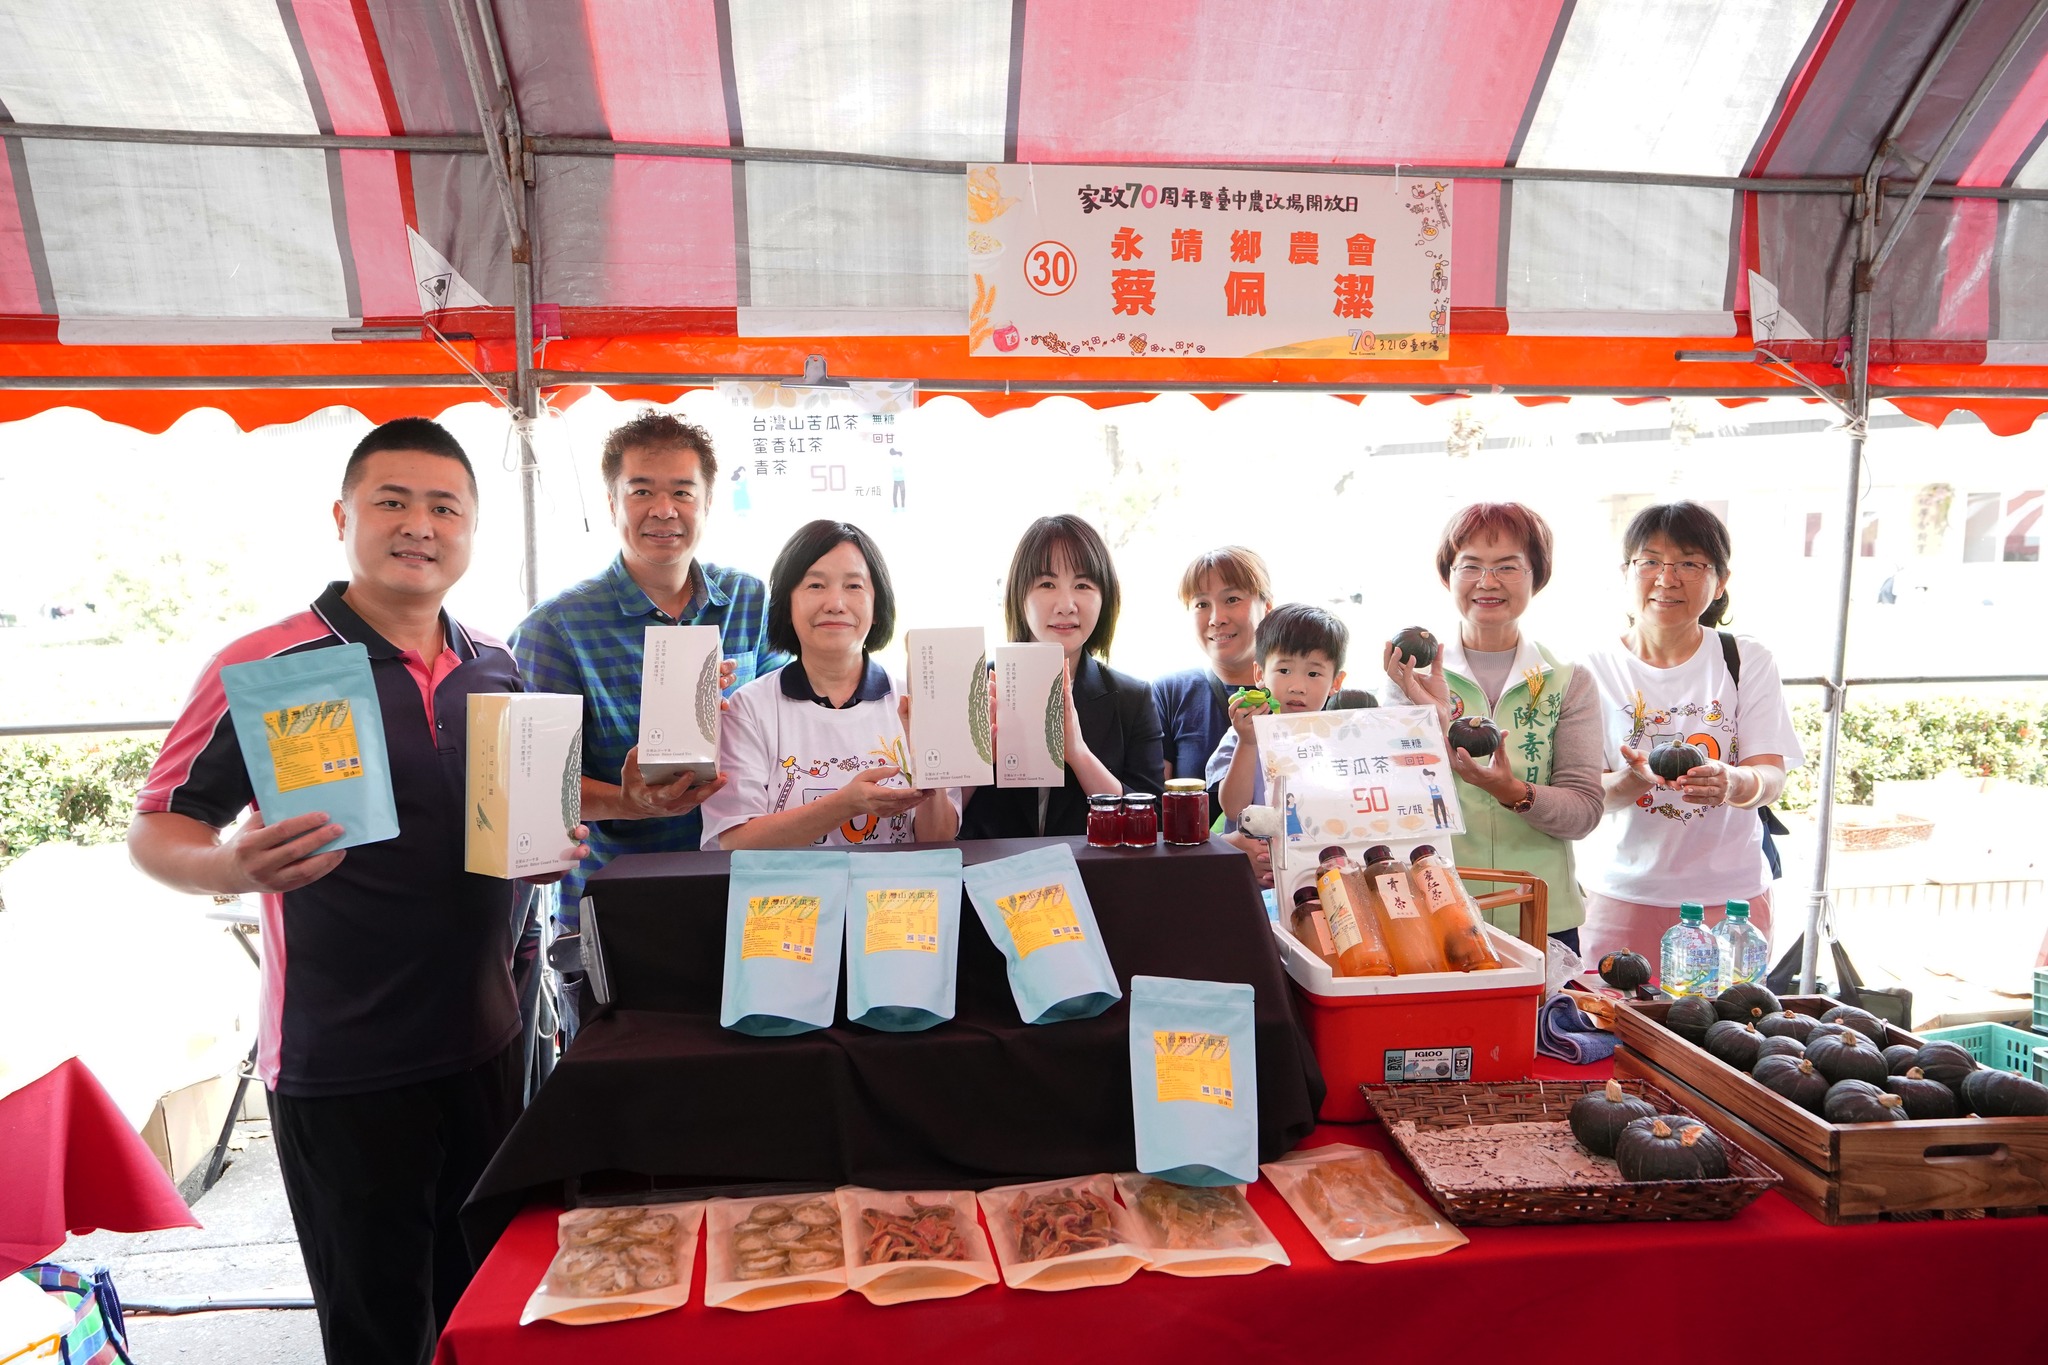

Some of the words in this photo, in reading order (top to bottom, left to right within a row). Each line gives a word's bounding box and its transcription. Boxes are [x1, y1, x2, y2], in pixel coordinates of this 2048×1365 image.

[1077, 182, 1359, 214] 家政70周年暨臺中農改場開放日
[1111, 227, 1377, 267] 永靖鄉農會
[1032, 250, 1070, 288] 30
[1111, 268, 1375, 319] 蔡佩潔
[753, 414, 859, 432] 台灣山苦瓜茶
[872, 414, 895, 426] 無糖
[752, 437, 823, 454] 蜜香紅茶
[872, 433, 895, 444] 回甘
[754, 460, 788, 476] 青茶
[810, 465, 846, 492] 50
[855, 486, 882, 497] 元/瓶
[1400, 738, 1422, 750] 無糖
[1513, 703, 1546, 785] 陳素日
[1312, 755, 1389, 777] 苦瓜茶
[1404, 755, 1425, 766] 回甘
[1353, 786, 1390, 814] 50
[1397, 803, 1424, 816] 元/瓶
[1387, 877, 1406, 910] 青茶
